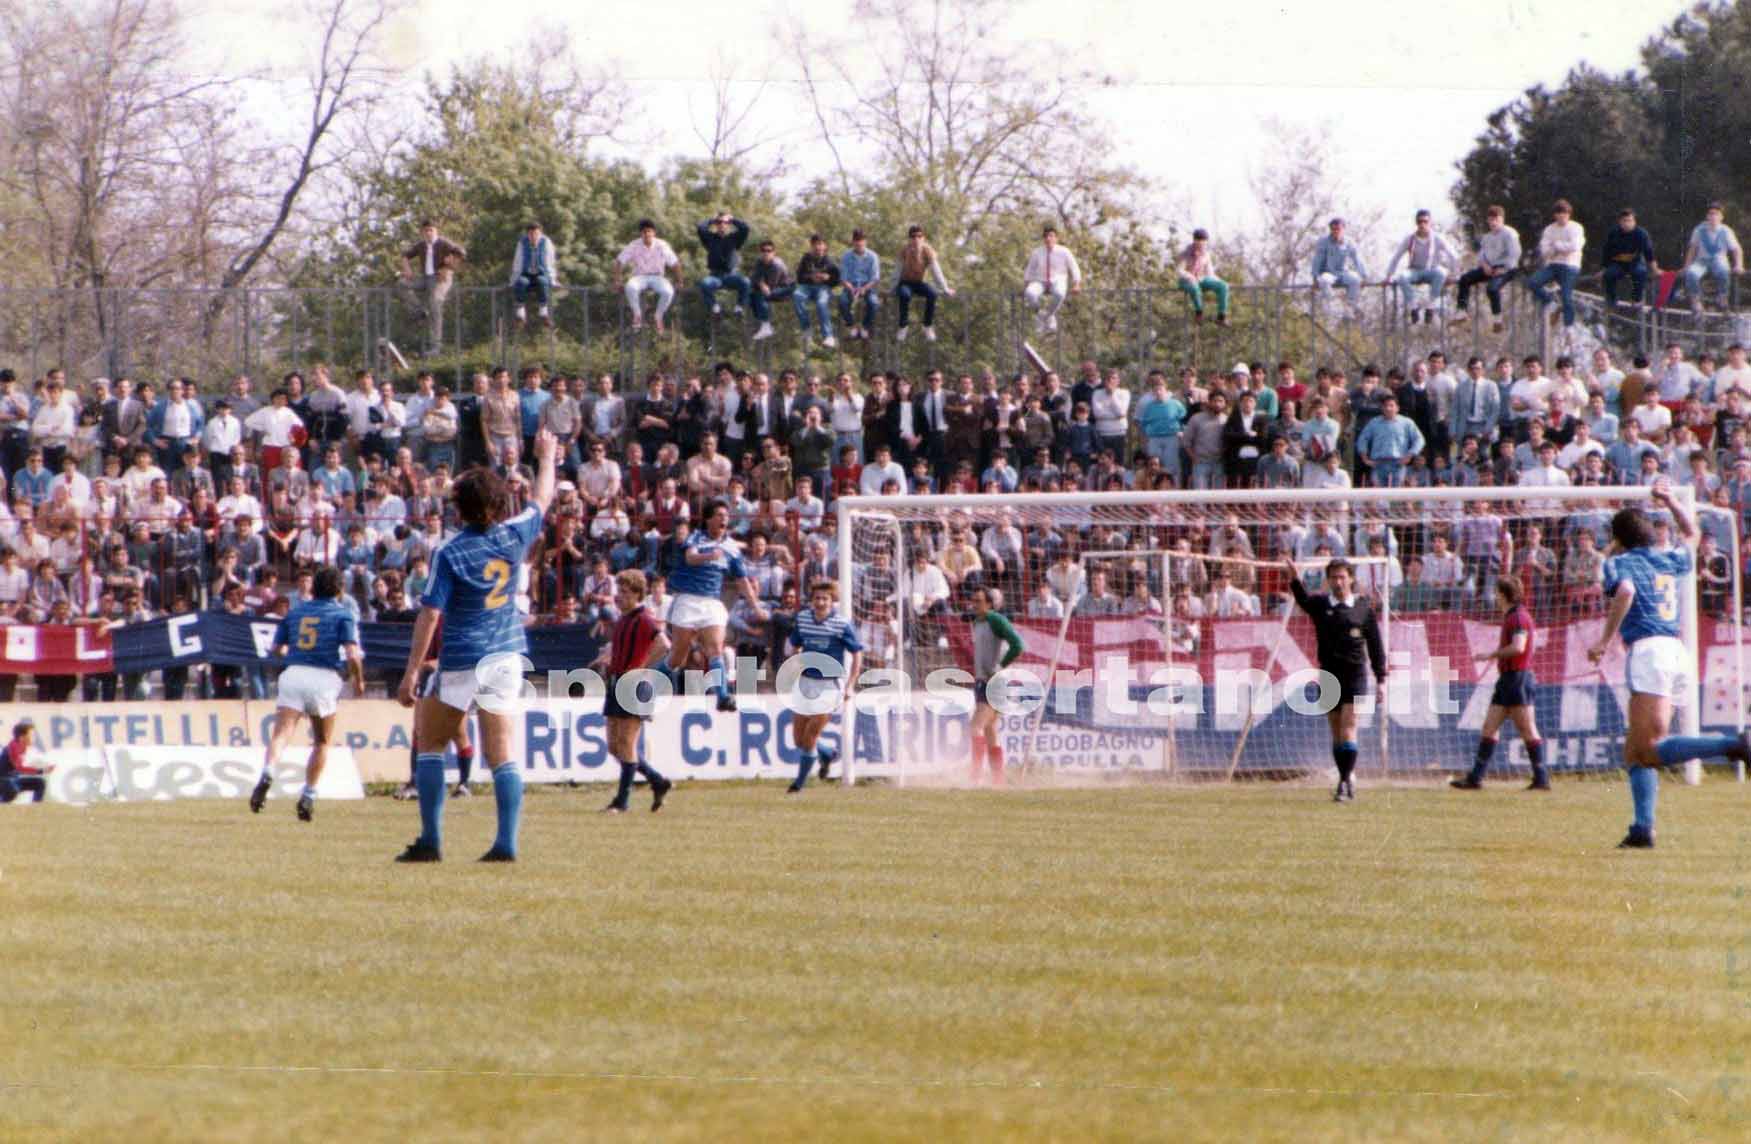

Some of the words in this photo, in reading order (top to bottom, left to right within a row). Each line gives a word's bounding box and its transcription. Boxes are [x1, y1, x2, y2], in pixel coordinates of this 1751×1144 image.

[483, 558, 510, 609] 2
[1654, 573, 1677, 622] 3
[299, 617, 320, 650] 5
[0, 713, 219, 750] APITELLI
[681, 712, 726, 766] C.
[740, 710, 970, 765] ROSARIO
[1006, 734, 1155, 752] RREDOBAGNO
